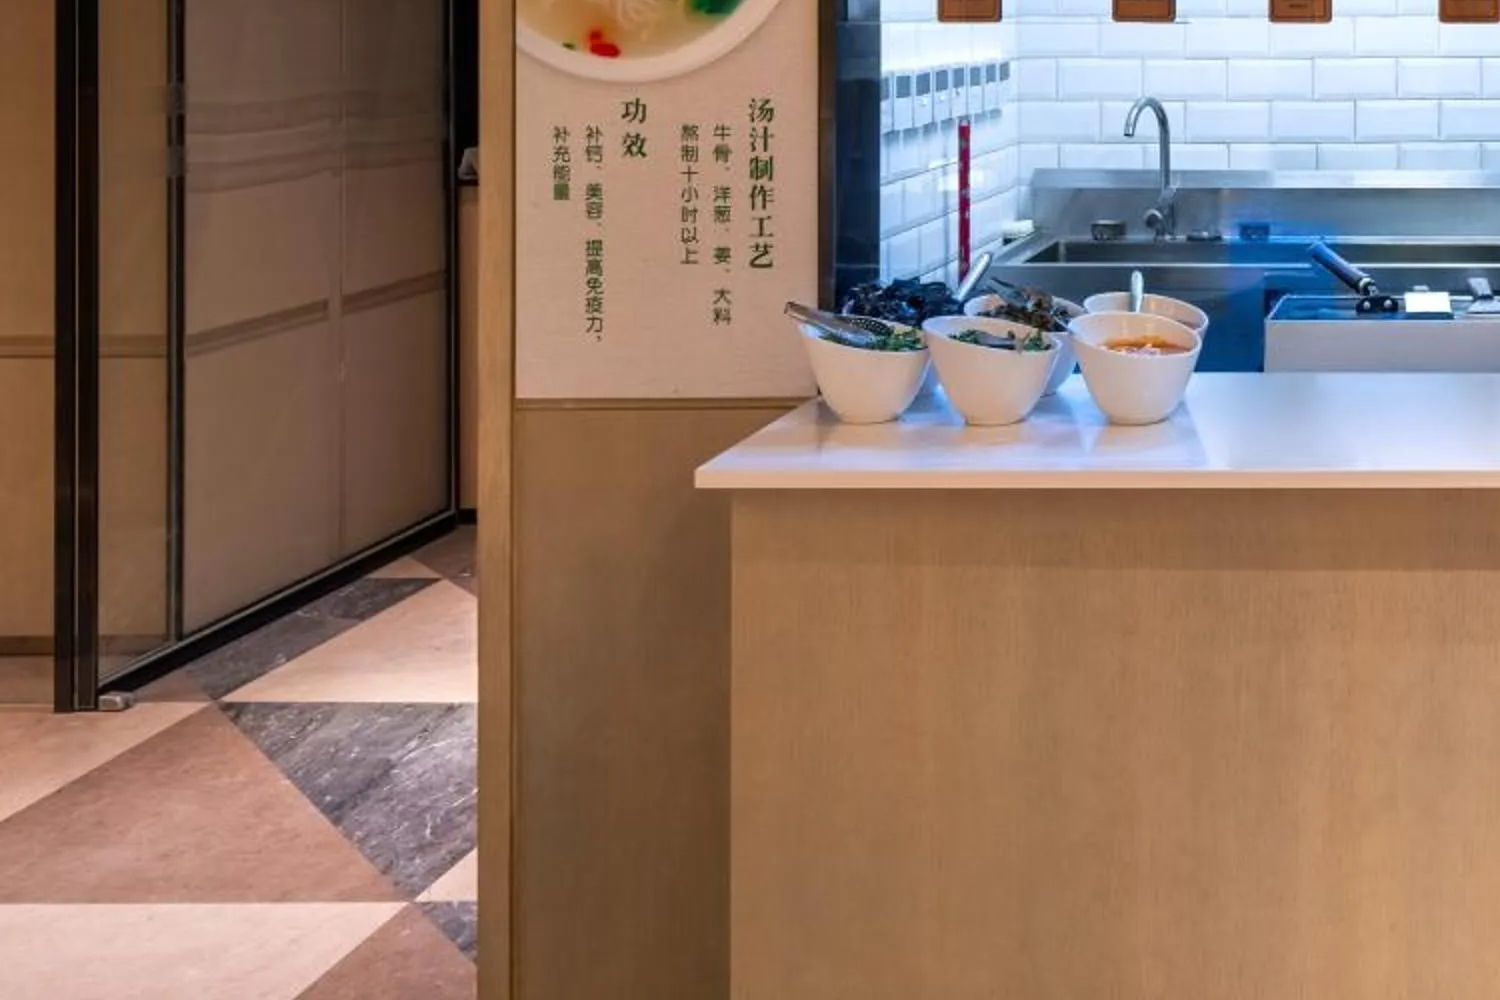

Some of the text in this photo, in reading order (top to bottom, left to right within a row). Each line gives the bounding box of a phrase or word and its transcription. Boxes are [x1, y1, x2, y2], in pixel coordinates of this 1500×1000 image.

[552, 125, 571, 201] 补充能量
[621, 97, 648, 159] 功效
[680, 124, 700, 265] 熬制十小时以上
[748, 98, 775, 269] 汤汁制作工艺
